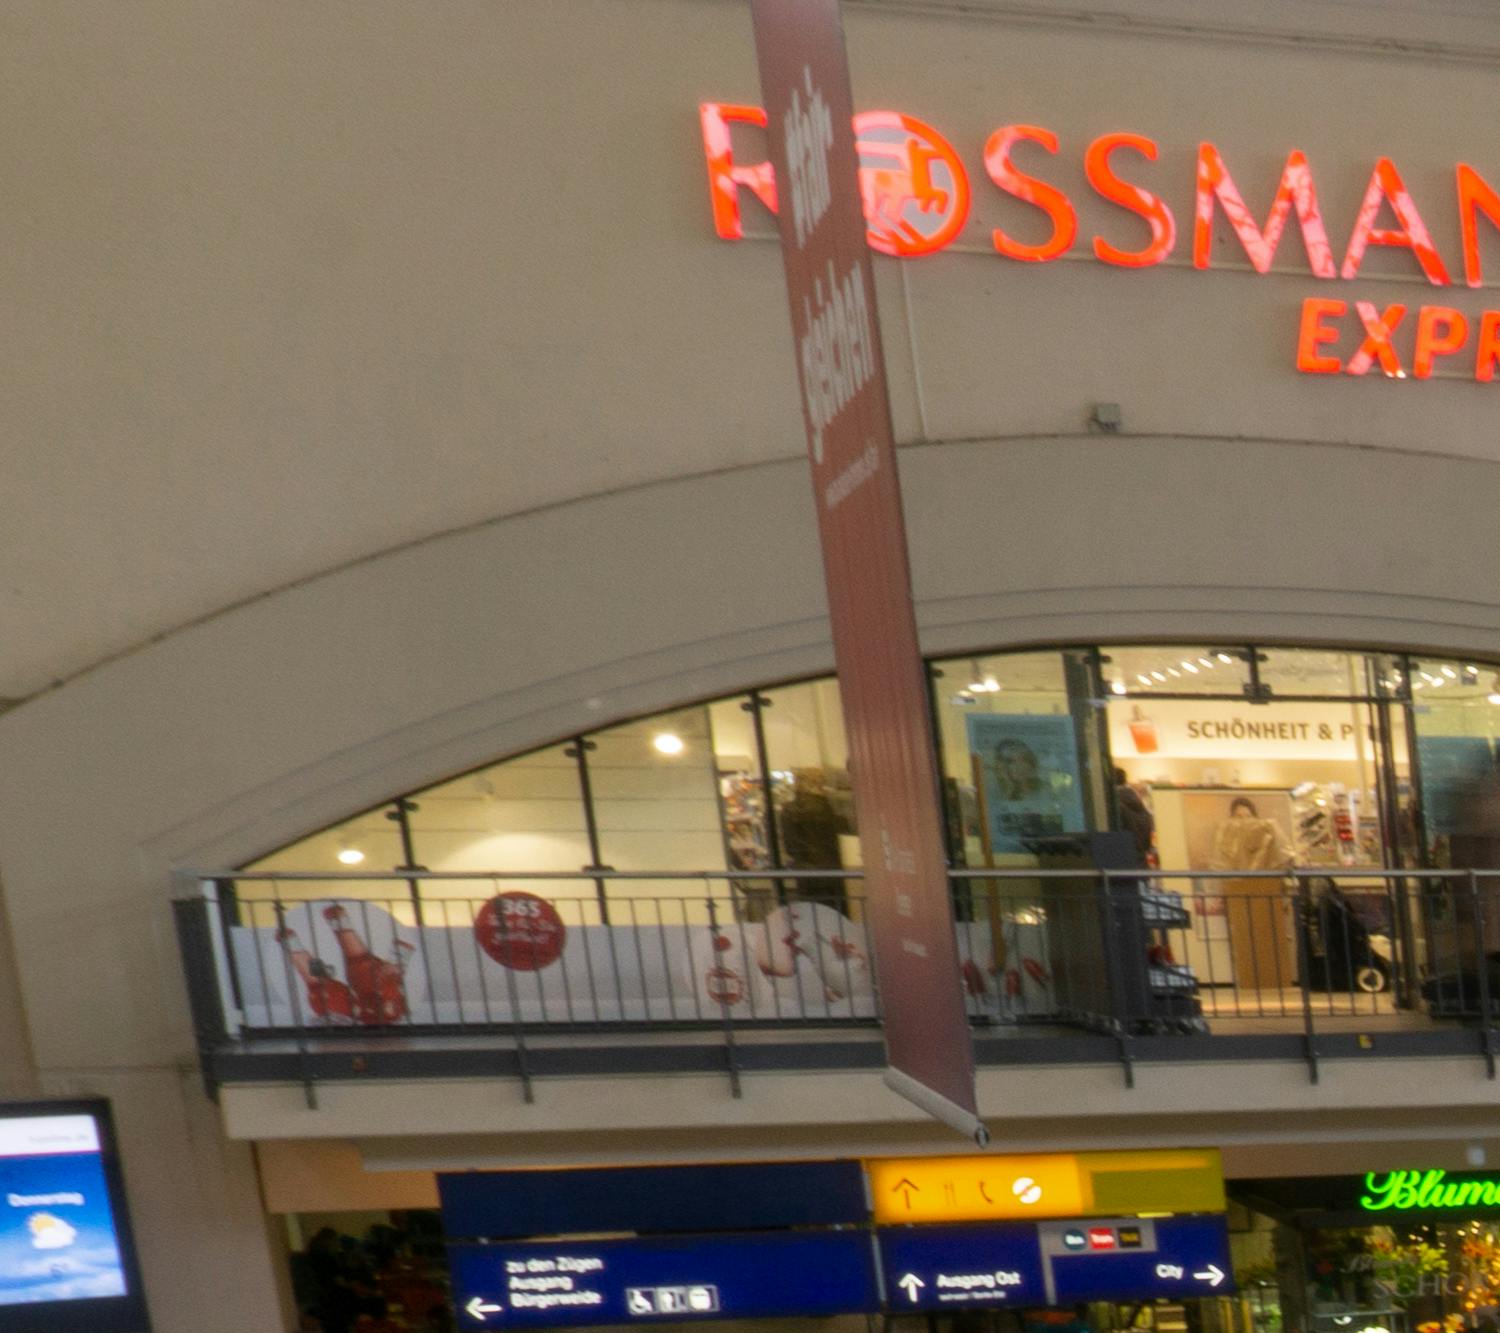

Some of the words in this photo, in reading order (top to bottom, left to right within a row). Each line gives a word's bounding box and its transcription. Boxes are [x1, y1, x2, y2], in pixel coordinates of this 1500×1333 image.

[1187, 718, 1309, 739] SCHÖNHEIT
[1317, 723, 1333, 739] &
[1156, 1263, 1183, 1280] City
